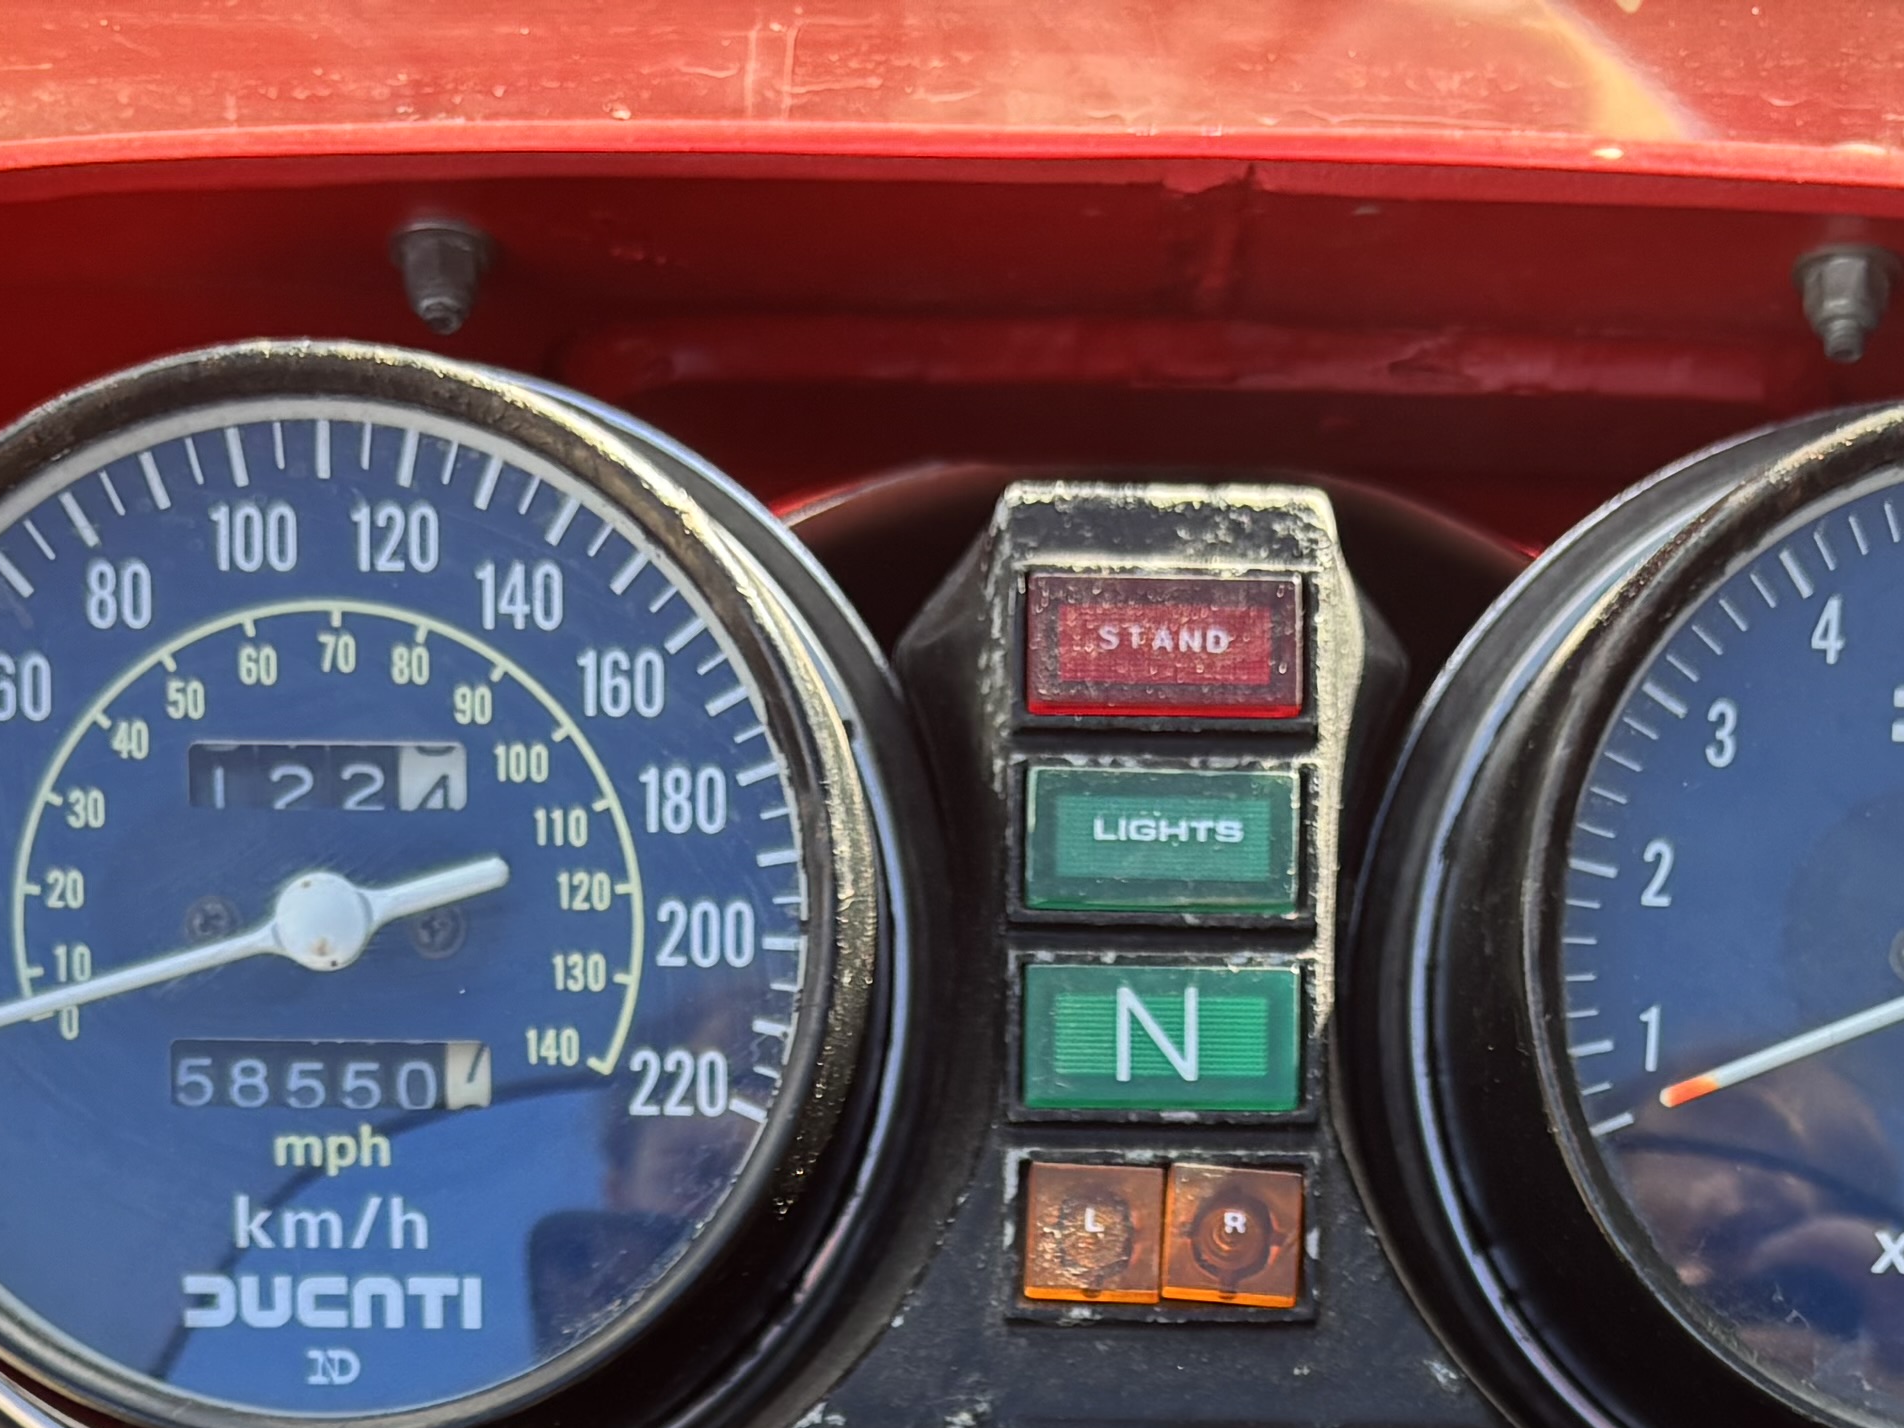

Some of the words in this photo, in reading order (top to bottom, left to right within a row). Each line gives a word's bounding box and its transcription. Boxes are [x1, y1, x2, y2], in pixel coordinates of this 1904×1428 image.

[210, 502, 298, 573] 100
[351, 502, 439, 573] 120
[86, 559, 152, 630] 80
[475, 561, 563, 631] 140
[1097, 625, 1231, 655] STAND
[1811, 595, 1845, 665] 4
[238, 644, 278, 686] 60
[317, 633, 356, 674] 70
[391, 644, 430, 686] 80
[166, 678, 205, 720] 50
[576, 648, 665, 718] 160
[453, 684, 493, 725] 90
[111, 719, 149, 760] 40
[1705, 700, 1737, 768] 3
[493, 742, 549, 783] 100
[66, 788, 106, 829] 30
[638, 764, 727, 835] 180
[534, 806, 588, 848] 110
[1093, 817, 1244, 844] LIGHTS
[46, 868, 85, 909] 20
[557, 870, 611, 911] 120
[1640, 839, 1674, 907] 2
[655, 899, 755, 968] 200
[55, 944, 91, 984] 10
[552, 952, 607, 992] 130
[60, 1005, 79, 1040] 0
[1115, 985, 1200, 1082] N
[1639, 1005, 1661, 1072] 1
[525, 1027, 580, 1067] 140
[629, 1048, 728, 1118] 220
[273, 1123, 391, 1177] mph
[235, 1194, 428, 1250] km/h
[1085, 1212, 1102, 1232] L
[1223, 1210, 1245, 1234] R
[182, 1274, 482, 1330] DUCATI
